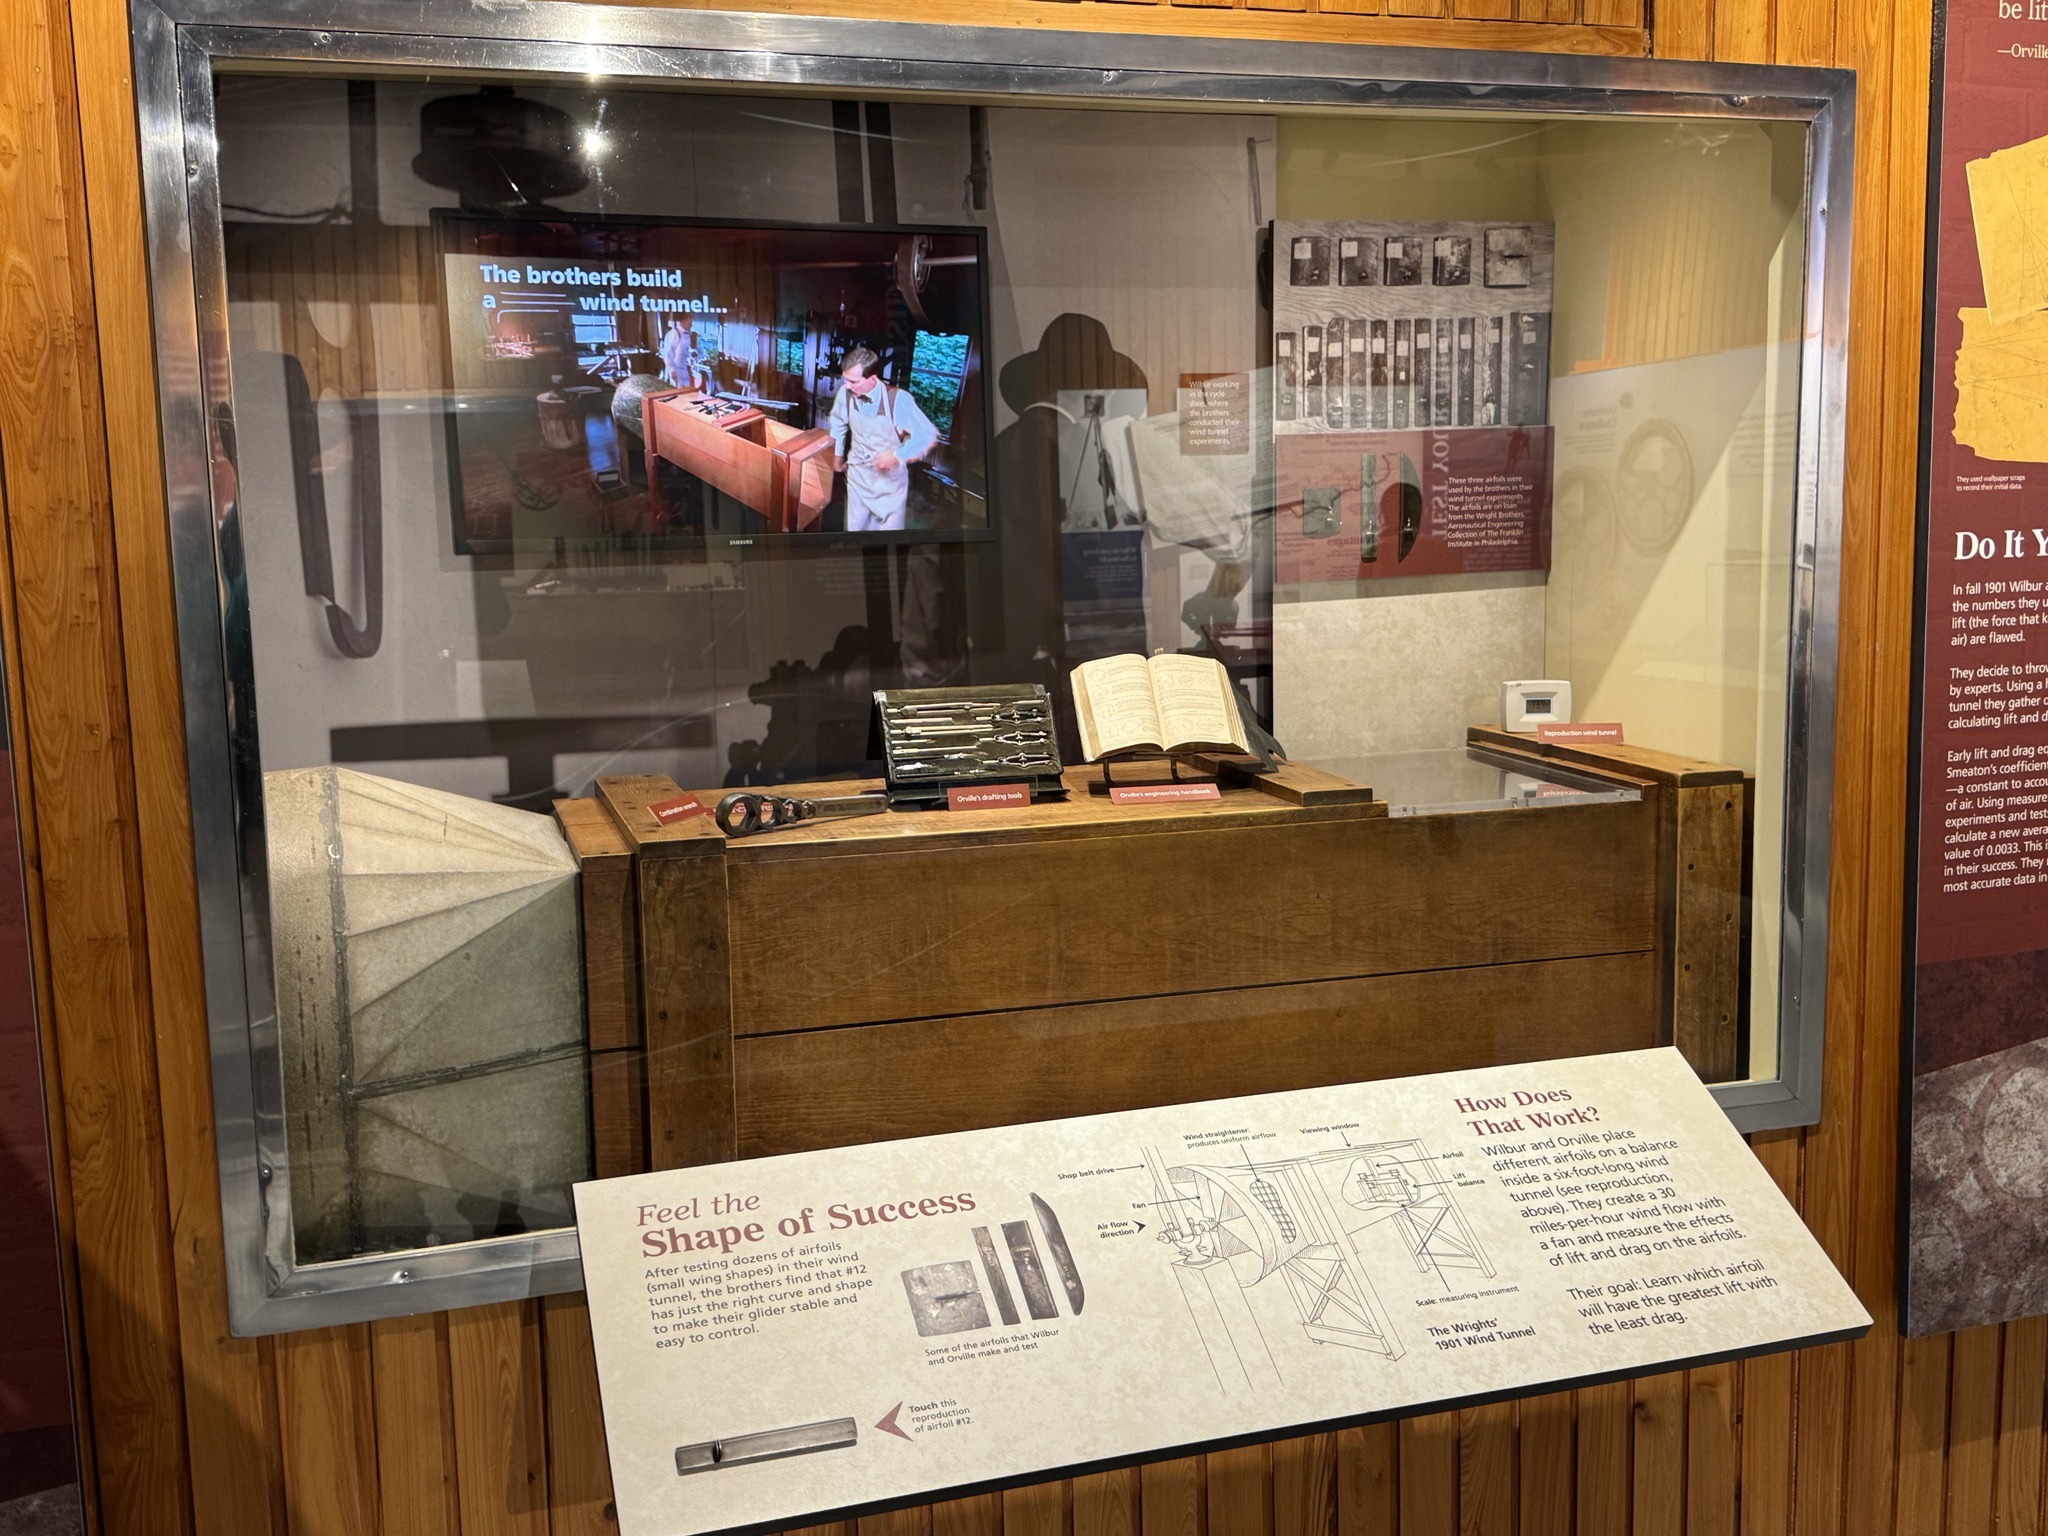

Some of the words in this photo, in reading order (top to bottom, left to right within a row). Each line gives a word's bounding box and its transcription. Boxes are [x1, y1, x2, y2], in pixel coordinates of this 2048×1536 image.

[1999, 0, 2022, 19] be
[480, 264, 520, 283] The
[526, 265, 621, 286] brothers
[627, 268, 682, 288] build
[482, 294, 496, 308] a
[579, 293, 634, 312] wind
[1212, 381, 1239, 389] working
[1954, 532, 1995, 560] Do
[2003, 530, 2024, 558] It
[1953, 584, 1962, 595] In
[1966, 582, 1980, 595] fall
[1985, 582, 2006, 594] 1901
[2009, 580, 2043, 593] Wilbur
[1952, 601, 1969, 612] the
[1972, 599, 2015, 611] numbers
[2018, 597, 2040, 610] they
[1952, 617, 1966, 629] lift
[1969, 616, 1989, 630] (the
[1992, 614, 2016, 627] force
[2019, 613, 2039, 625] that
[1951, 633, 1967, 646] air)
[1970, 635, 1986, 644] are
[1989, 630, 2026, 643] flawed.
[982, 792, 1006, 802] drafting
[1008, 791, 1022, 800] tools
[1944, 848, 1970, 860] value
[1973, 845, 1984, 857] of
[1986, 843, 2020, 856] 0.0033.
[2024, 840, 2042, 852] This
[1943, 880, 1968, 893] most
[1970, 876, 2010, 890] accurate
[2014, 874, 2035, 885] data
[1453, 1094, 1507, 1114] How
[1511, 1088, 1572, 1108] Does
[1299, 1125, 1330, 1135] Viewing
[1331, 1122, 1360, 1131] window
[1467, 1117, 1525, 1137] That
[1526, 1106, 1600, 1131] Work?
[1183, 1132, 1204, 1141] Wind
[1187, 1139, 1220, 1150] produces
[1221, 1135, 1249, 1145] uniform
[1251, 1131, 1277, 1141] airflow
[1481, 1142, 1528, 1157] Wilbur
[1530, 1138, 1555, 1152] and
[1558, 1132, 1600, 1148] Orville
[1601, 1128, 1636, 1143] place
[1442, 1151, 1464, 1160] Airfoil
[1492, 1155, 1551, 1172] different
[1553, 1146, 1596, 1163] airfoils
[1598, 1146, 1617, 1158] on
[1619, 1145, 1628, 1156] a
[1630, 1138, 1678, 1153] balance
[1058, 1172, 1077, 1180] Shop
[1079, 1169, 1095, 1177] belt
[1096, 1166, 1115, 1175] drive
[1458, 1178, 1485, 1188] balance
[636, 1198, 701, 1227] Feel
[712, 1192, 761, 1216] the
[1132, 1201, 1146, 1210] Fan
[642, 1221, 764, 1259] Shape
[778, 1207, 816, 1238] of
[828, 1192, 976, 1231] Success
[1097, 1222, 1108, 1231] Air
[1110, 1220, 1129, 1228] flow
[1100, 1228, 1134, 1239] direction
[645, 1263, 679, 1280] After
[683, 1258, 729, 1277] testing
[733, 1251, 778, 1267] dozens
[782, 1246, 795, 1259] of
[799, 1241, 842, 1257] airfoils
[646, 1277, 685, 1295] (small
[689, 1275, 722, 1290] wing
[726, 1264, 774, 1284] shapes)
[778, 1261, 790, 1274] in
[793, 1256, 824, 1271] their
[827, 1251, 859, 1266] wind
[1566, 1285, 1604, 1302] Their
[1608, 1279, 1642, 1297] goal:
[1642, 1274, 1682, 1288] Learn
[1683, 1267, 1724, 1283] which
[1726, 1258, 1765, 1276] airfoil
[1416, 1299, 1437, 1307] Scale:
[1439, 1292, 1478, 1304] measuring
[1478, 1286, 1519, 1297] instrument
[1427, 1326, 1449, 1337] The
[1435, 1339, 1463, 1351] 1901
[1463, 1333, 1496, 1346] Wind
[1496, 1326, 1536, 1341] Tunnel
[925, 1347, 950, 1356] Some
[952, 1343, 961, 1352] of
[963, 1342, 978, 1351] the
[980, 1336, 1009, 1348] airfoils
[1011, 1334, 1029, 1342] that
[1030, 1328, 1060, 1339] Wilbur
[928, 1356, 945, 1366] and
[947, 1352, 976, 1362] Orville
[978, 1348, 1001, 1358] make
[1003, 1344, 1020, 1353] and
[1022, 1342, 1038, 1350] test
[908, 1402, 938, 1413] Touch
[940, 1398, 957, 1408] this
[912, 1406, 970, 1423] reproduction
[914, 1424, 924, 1433] of
[927, 1419, 954, 1431] airfoil
[956, 1416, 974, 1426] #12.
